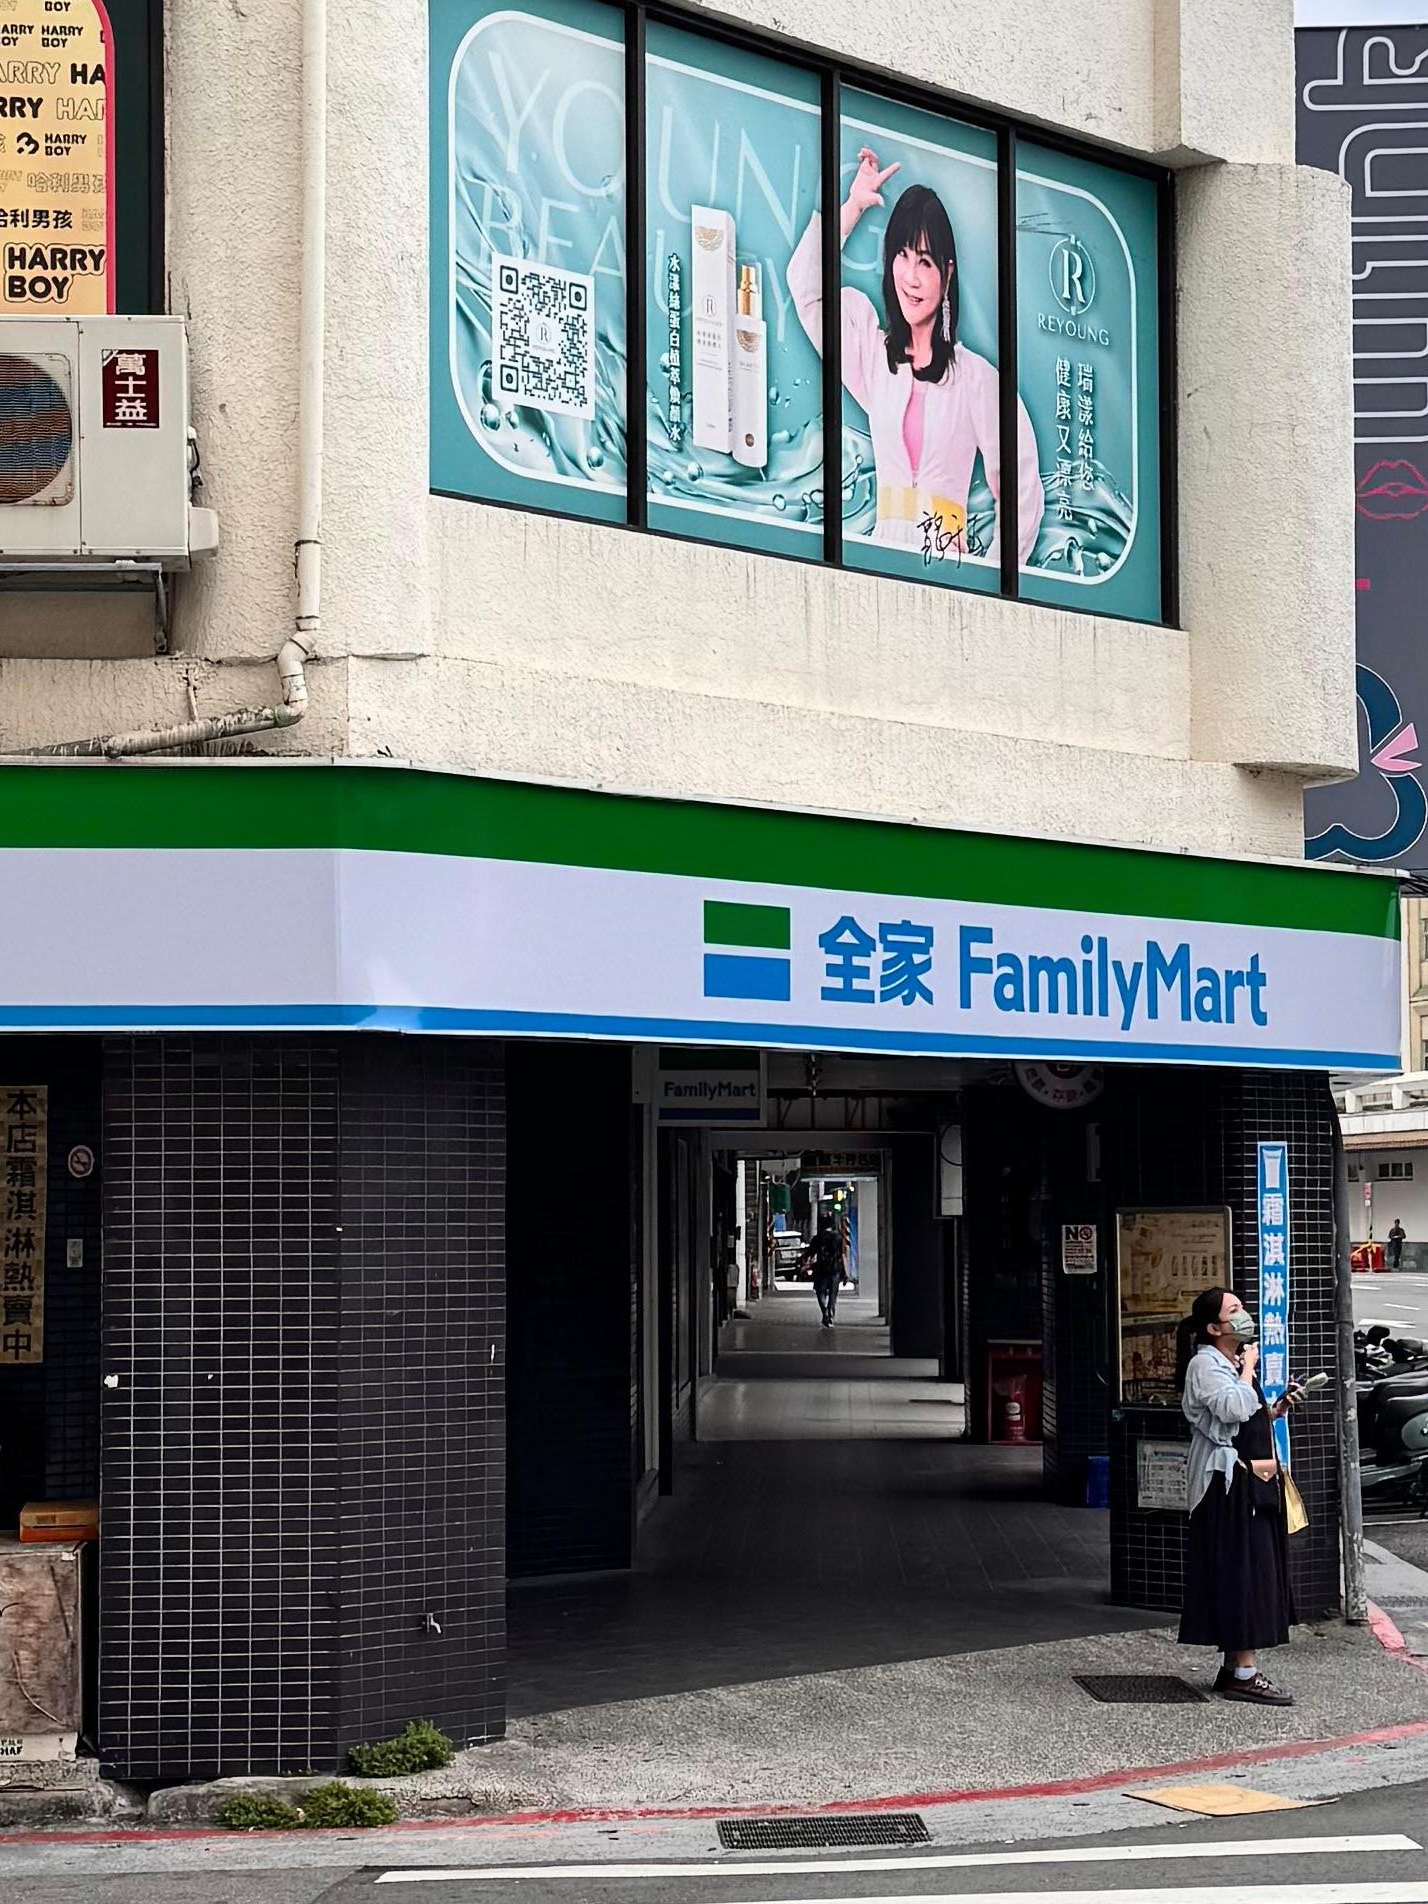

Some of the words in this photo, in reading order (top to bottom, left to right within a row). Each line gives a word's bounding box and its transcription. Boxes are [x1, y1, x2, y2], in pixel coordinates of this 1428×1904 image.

[44, 1, 71, 12] BOY
[41, 25, 83, 37] HARRY
[41, 37, 68, 48] BOY
[45, 134, 87, 145] HARRY
[45, 145, 71, 156] BOY
[7, 247, 105, 271] HARRY
[8, 275, 70, 299] BOY
[1038, 312, 1110, 346] REYOUNG
[115, 352, 148, 421] 萬士益
[818, 915, 934, 1007] 全家
[959, 924, 1269, 1032] FamilyMart
[664, 1080, 756, 1101] FamilyMart
[1, 1090, 38, 1361] 本店霜淇淋熱賣中
[1261, 1193, 1286, 1402] 霜淇淋熱賣
